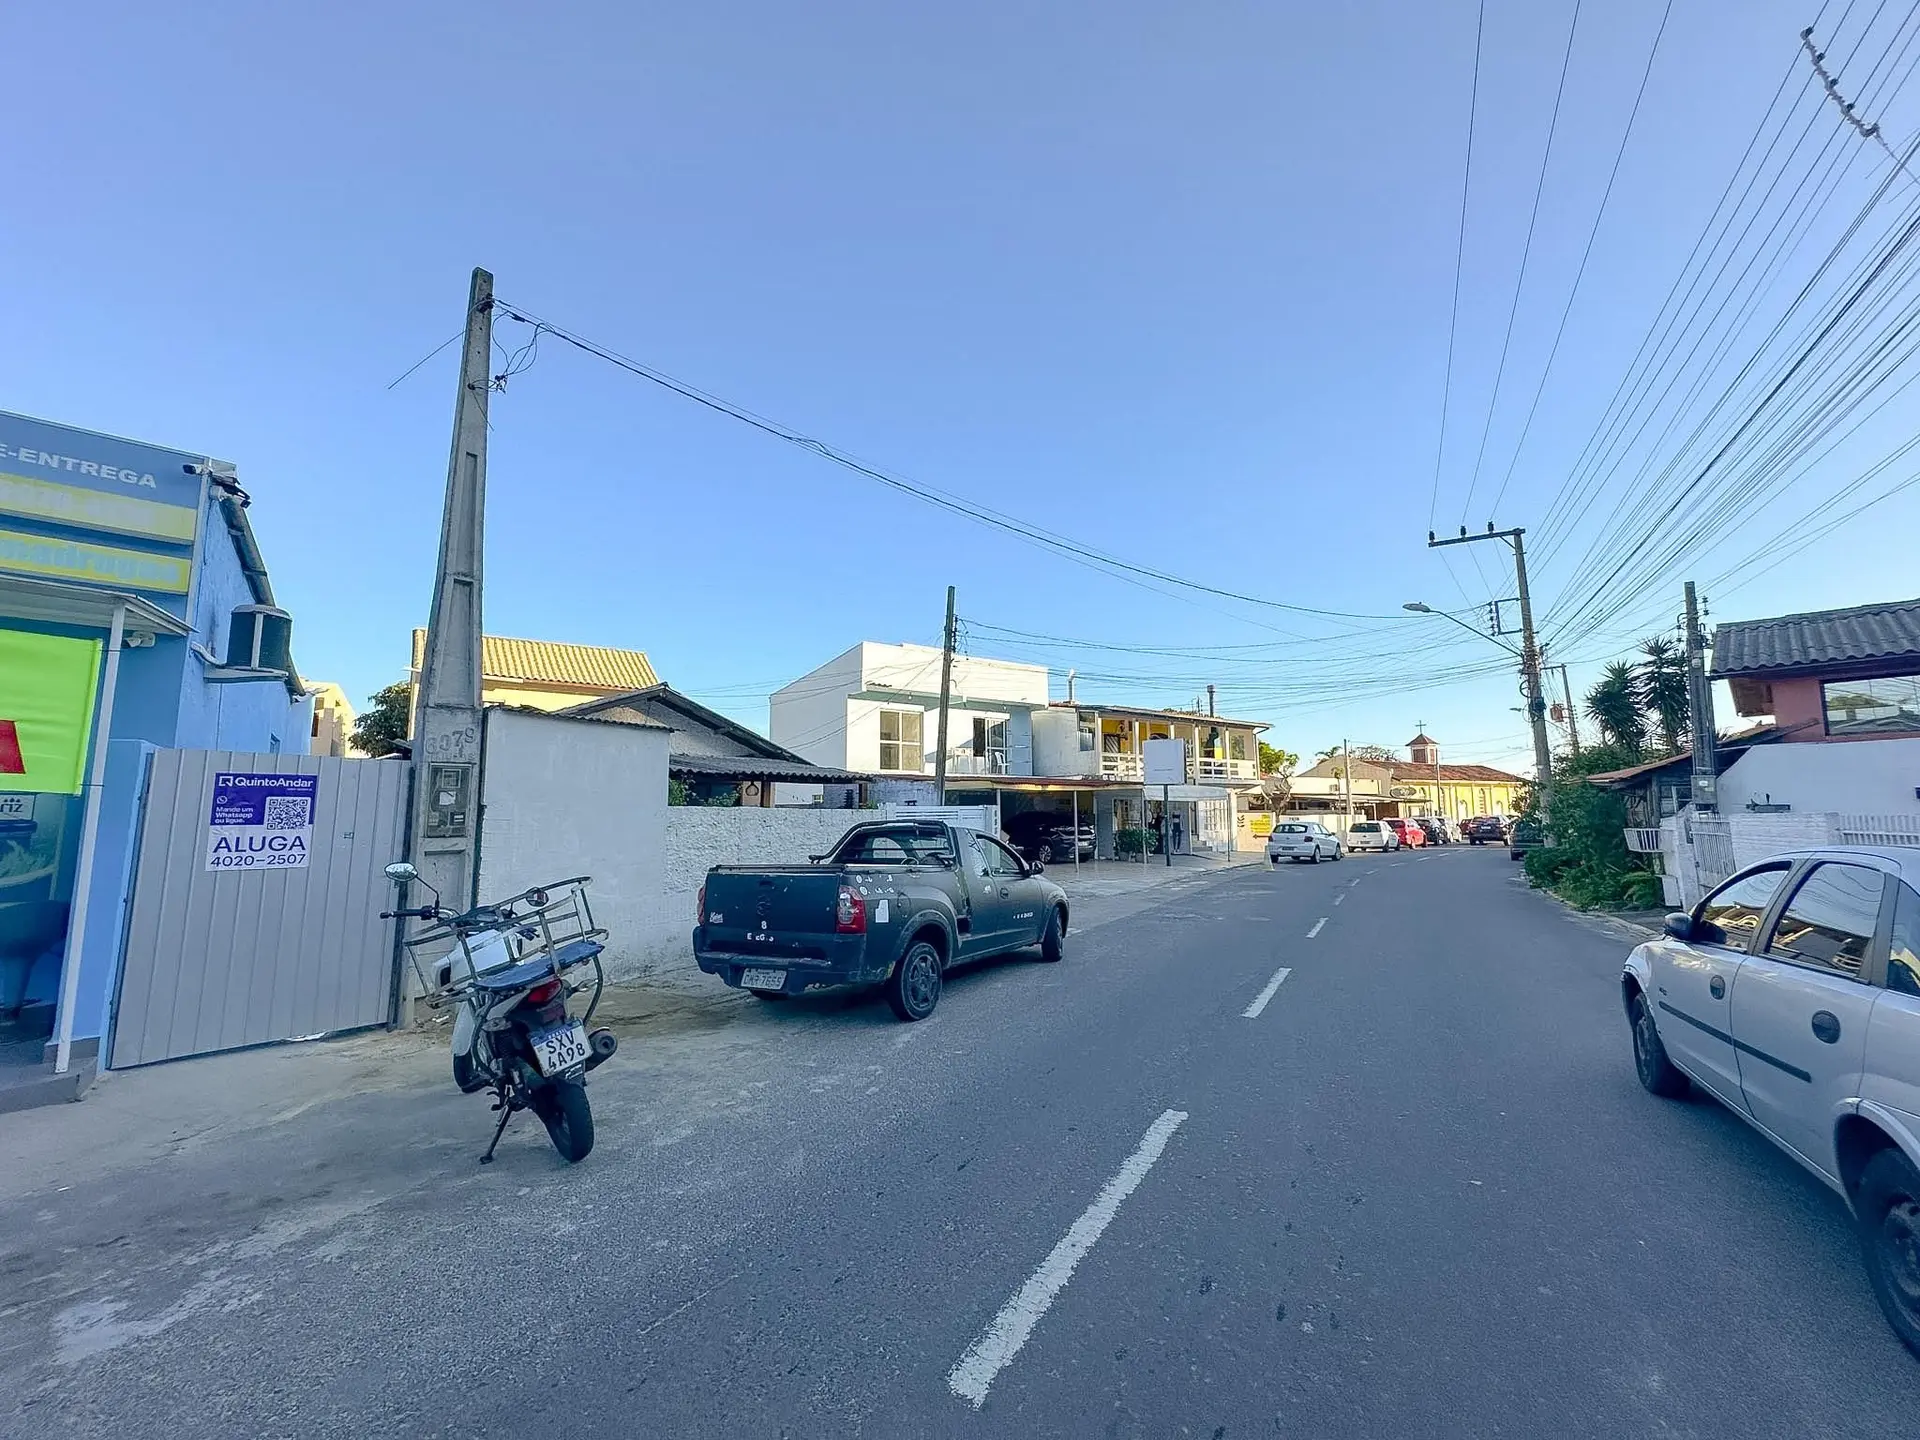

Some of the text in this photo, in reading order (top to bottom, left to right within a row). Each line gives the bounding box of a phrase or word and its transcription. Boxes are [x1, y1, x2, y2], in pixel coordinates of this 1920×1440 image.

[235, 776, 314, 788] QuintoAndar
[213, 835, 306, 854] ALUGA
[211, 853, 306, 867] 4020-2507
[545, 1030, 576, 1054] SXV
[548, 1042, 586, 1070] 4A98
